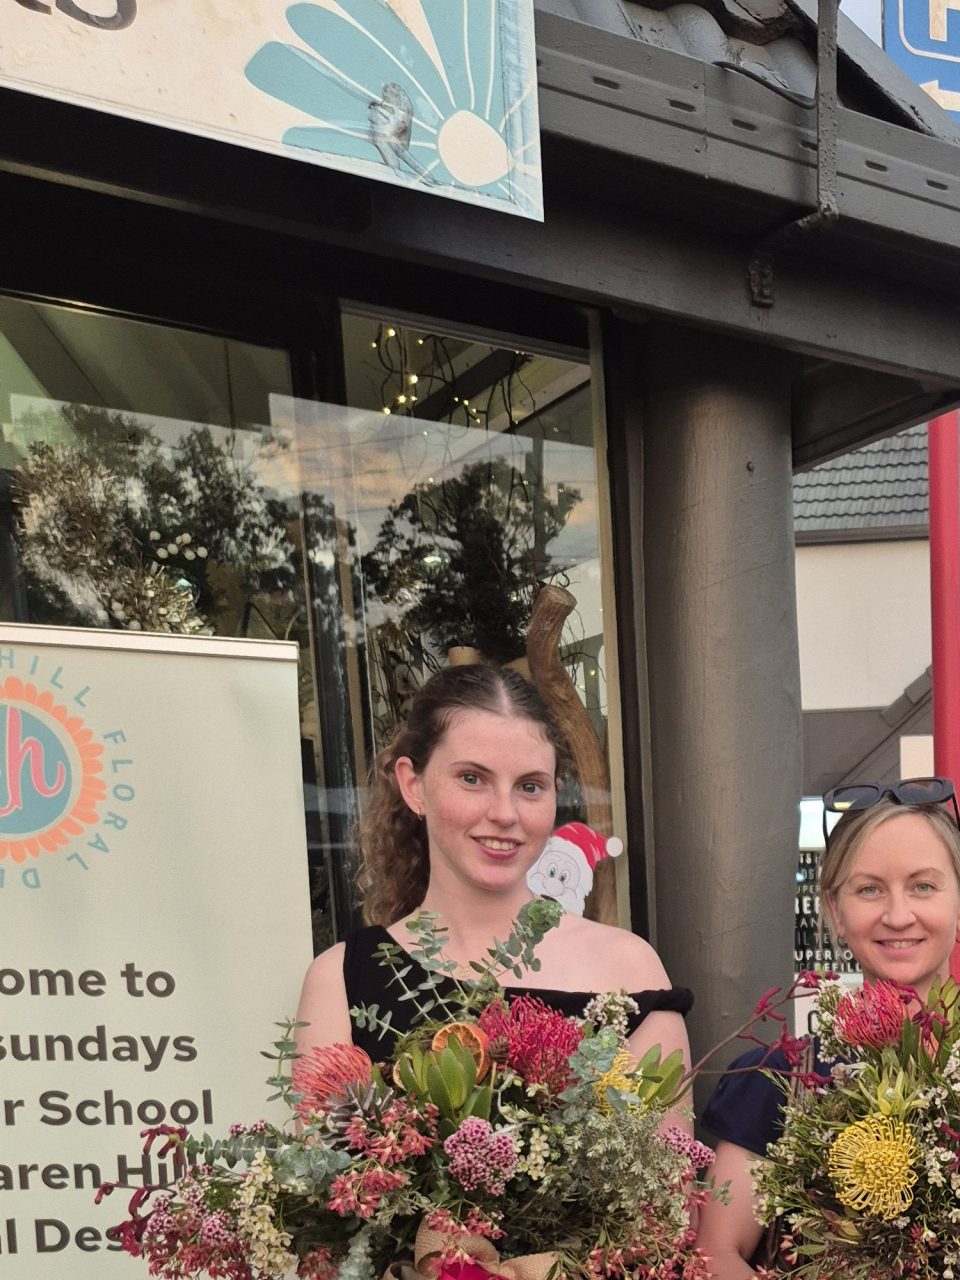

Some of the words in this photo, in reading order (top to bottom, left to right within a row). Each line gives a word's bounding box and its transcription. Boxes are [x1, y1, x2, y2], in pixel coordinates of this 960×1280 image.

[66, 729, 135, 871] FLORAL
[121, 962, 176, 998] to
[0, 1025, 198, 1072] undays
[39, 1089, 214, 1126] School
